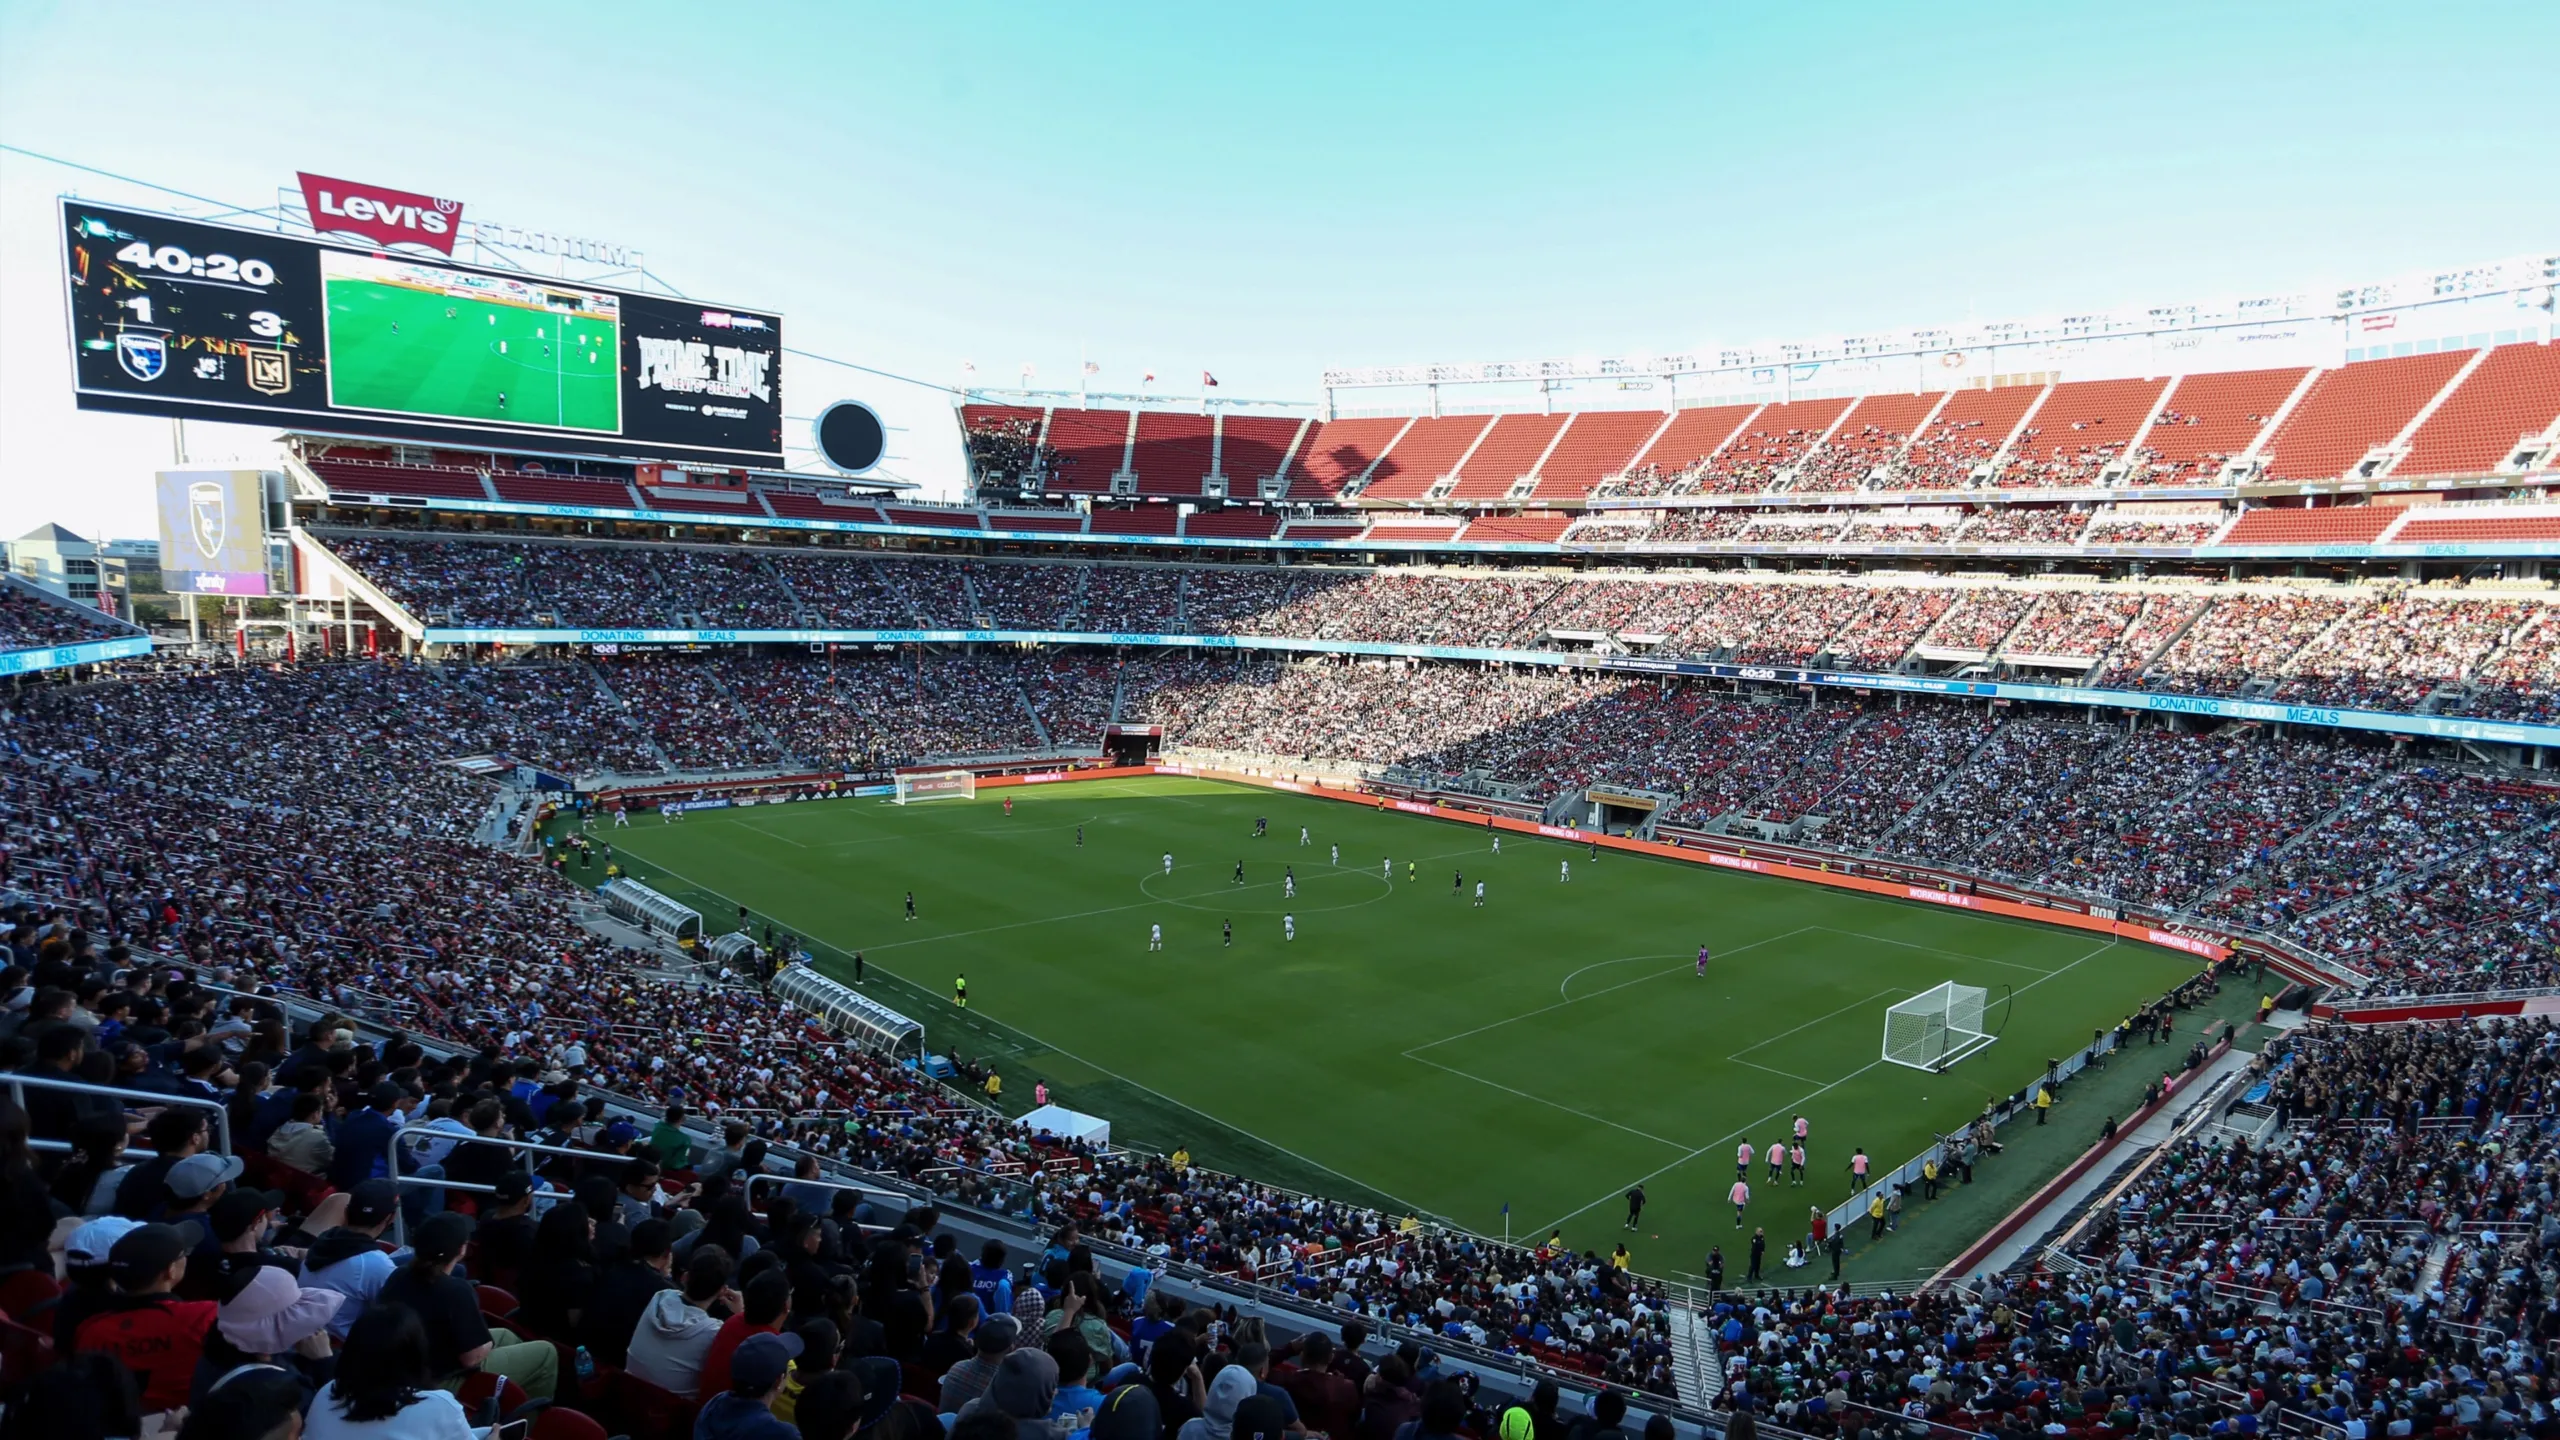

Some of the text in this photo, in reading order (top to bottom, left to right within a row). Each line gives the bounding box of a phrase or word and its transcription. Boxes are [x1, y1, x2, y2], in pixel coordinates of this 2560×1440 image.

[318, 190, 634, 268] Levi's STADIUM
[116, 240, 275, 286] 40:20
[127, 295, 153, 323] 1
[249, 310, 284, 337] 3
[637, 335, 772, 404] PRIME TIME
[706, 379, 751, 399] STADIUM
[548, 506, 594, 516] DONATING
[633, 511, 663, 520] MEALS
[768, 518, 863, 530] DONATING MEALS
[951, 530, 1036, 540] DONATING MEALS
[2315, 545, 2467, 555] DONATING MEALS
[581, 631, 645, 640] DONATING
[698, 631, 736, 640] MEALS
[876, 632, 925, 640] DONATING
[966, 632, 995, 640] MEALS
[1111, 634, 1161, 644] DONATING
[1203, 637, 1236, 646] MEALS
[873, 643, 895, 652] xfinity
[1346, 643, 1461, 657] DONATING MEALS
[54, 648, 78, 665] MEALS
[1629, 661, 1677, 671] EARTHQUAKES
[1739, 668, 1776, 679] 40:20
[1798, 672, 1807, 682] 3
[1823, 675, 1947, 690] LOS ANGELES FOOTBALL CLUB
[2149, 696, 2340, 724] DONATING 51,000 MEALS
[684, 798, 727, 810] atlantic.net
[1396, 801, 1418, 812] WORKING
[1539, 825, 1580, 839] WORKING ON A
[1709, 854, 1758, 870] WORKING ON A
[1909, 888, 1968, 906] WORKING ON A
[2128, 917, 2141, 926] OF
[2163, 921, 2229, 948] Faithful
[2149, 930, 2211, 955] WORKING ON A
[795, 968, 910, 1026] EARTH QUAKES
[1138, 1338, 1155, 1370] 7
